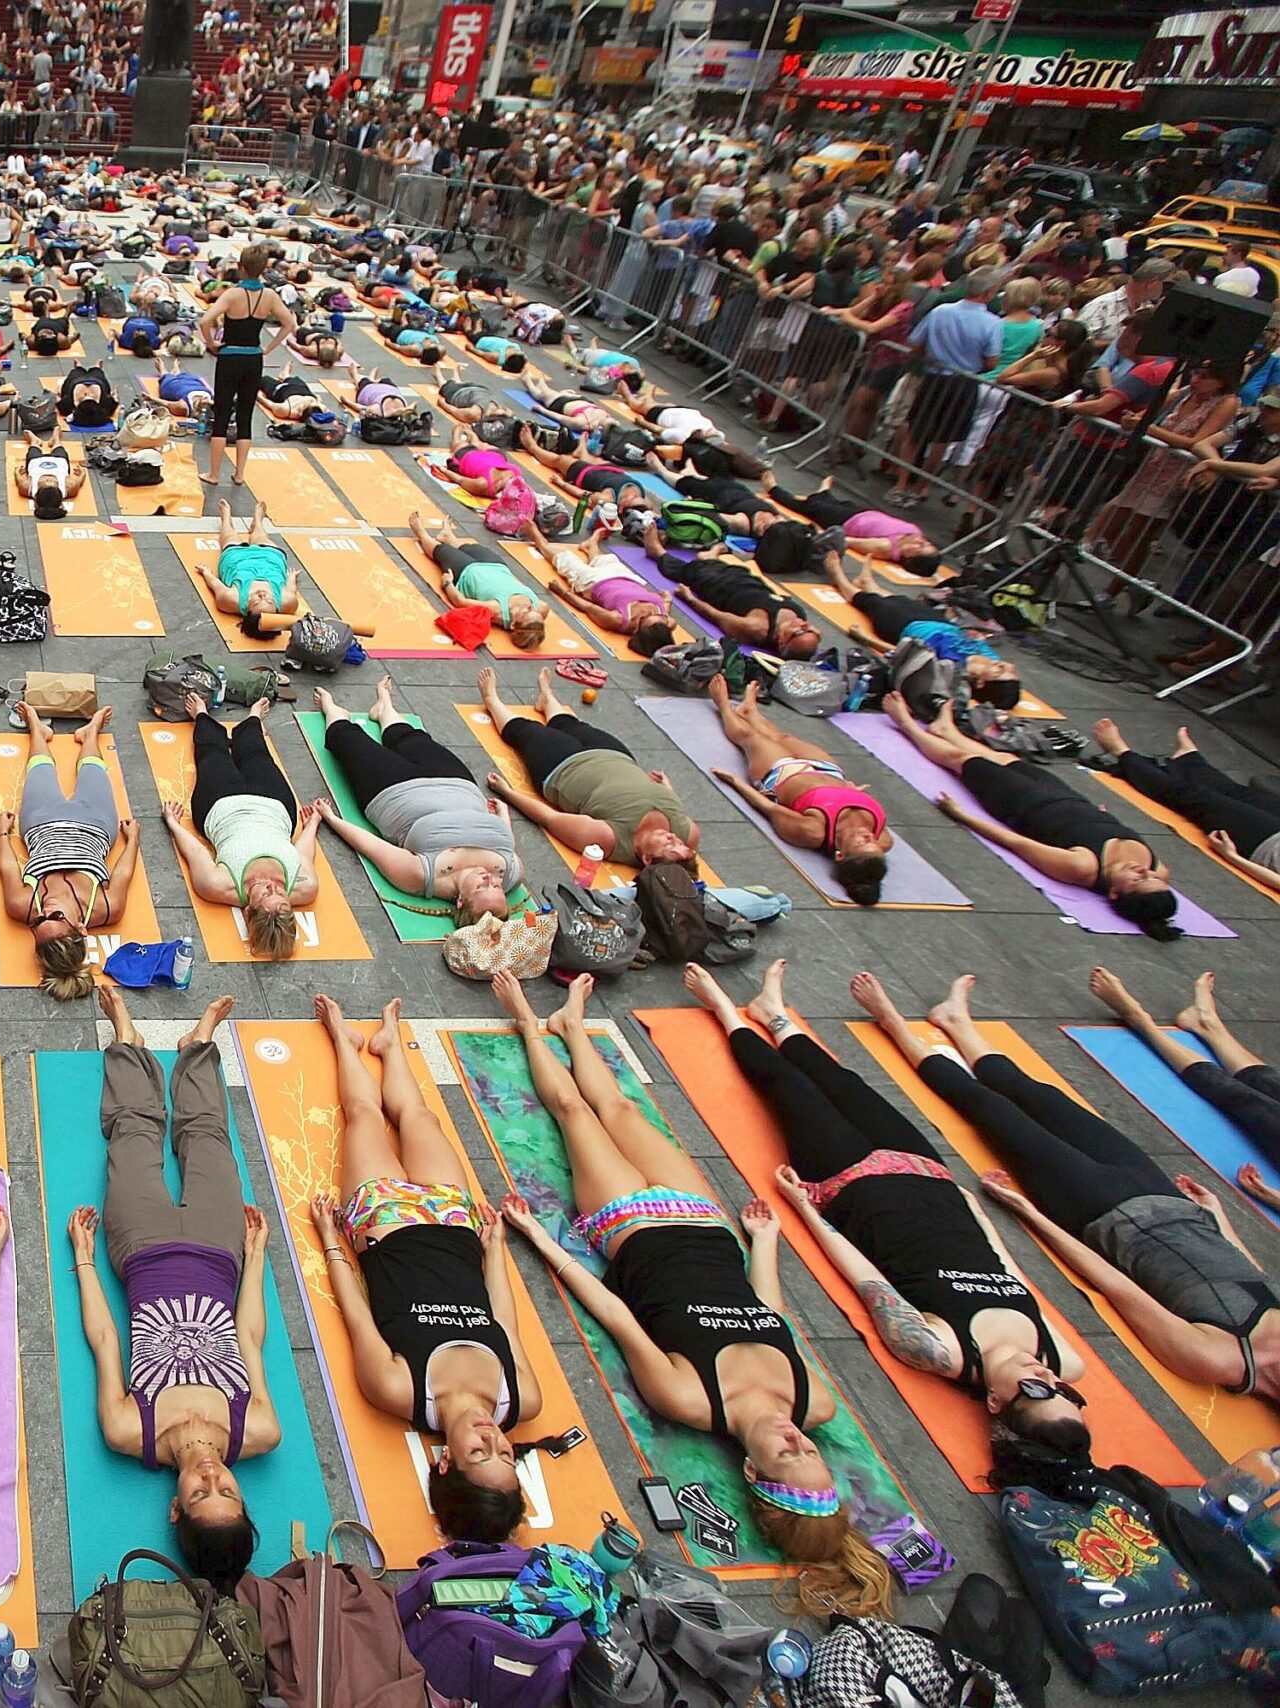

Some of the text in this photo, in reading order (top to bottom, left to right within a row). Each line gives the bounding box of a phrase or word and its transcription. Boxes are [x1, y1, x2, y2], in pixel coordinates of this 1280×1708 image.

[443, 11, 483, 78] tkts
[938, 1269, 992, 1281] sweaty
[951, 1282, 1027, 1297] get haute
[410, 1303, 459, 1314] sweaty
[686, 1304, 743, 1316] sweaty
[418, 1315, 491, 1329] get haute
[699, 1316, 781, 1332] get haute
